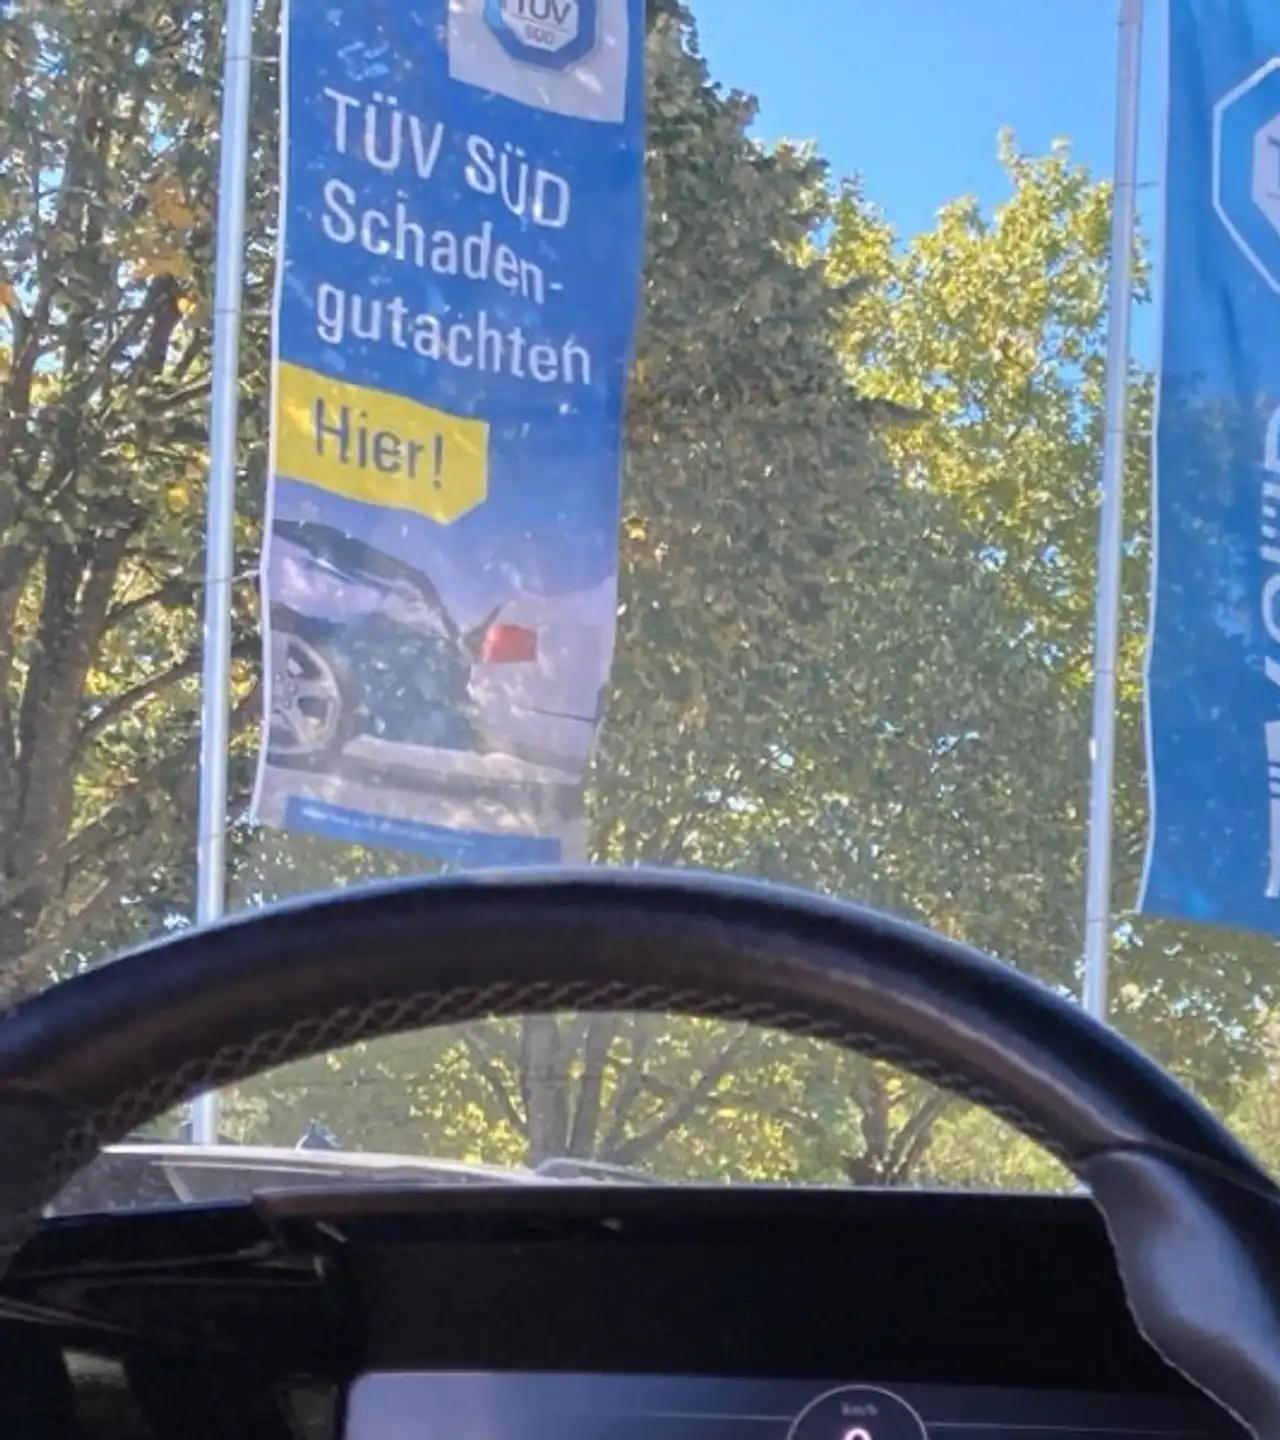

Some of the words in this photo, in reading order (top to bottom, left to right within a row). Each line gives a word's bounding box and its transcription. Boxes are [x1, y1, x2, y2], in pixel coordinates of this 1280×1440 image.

[323, 88, 444, 179] TÜV
[464, 135, 570, 229] SÜD
[321, 179, 564, 305] Schaden-
[316, 282, 591, 386] gutachten
[313, 398, 444, 490] Hier!
